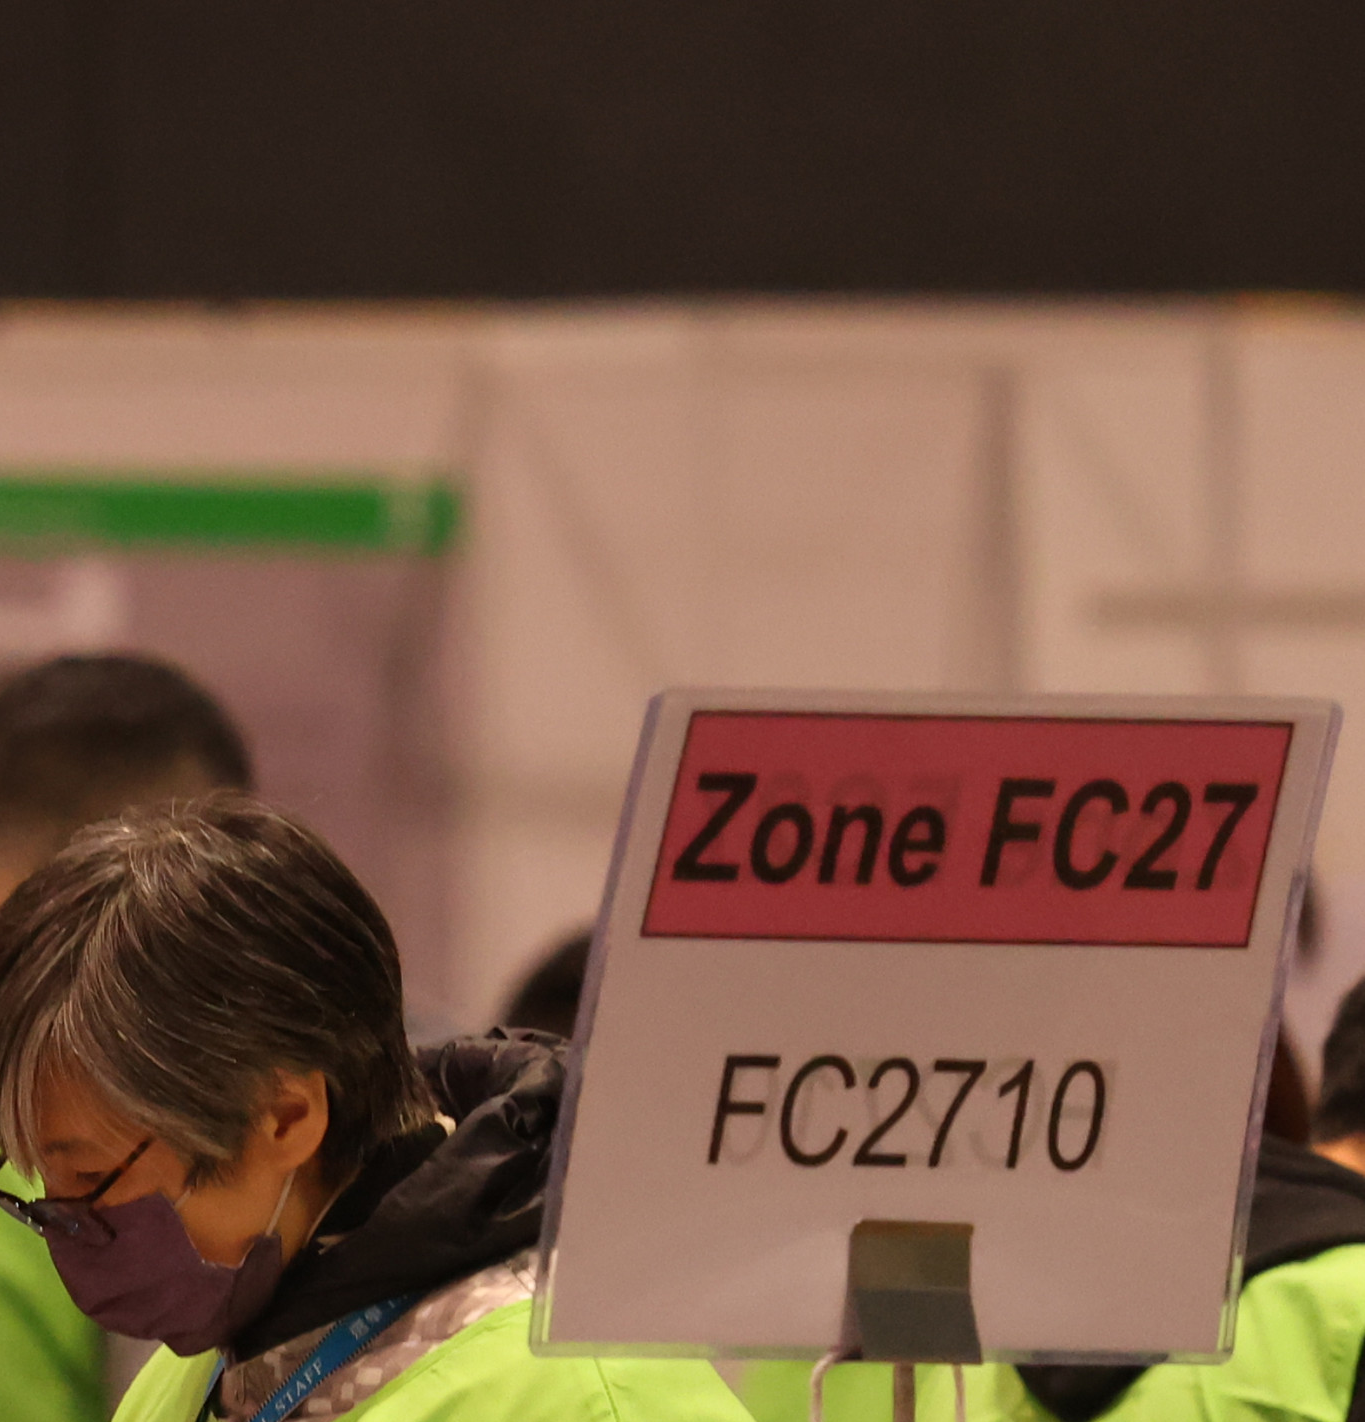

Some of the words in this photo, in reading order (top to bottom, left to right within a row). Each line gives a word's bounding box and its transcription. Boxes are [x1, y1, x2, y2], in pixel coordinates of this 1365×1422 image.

[670, 772, 948, 888] Zone
[980, 776, 1260, 892] FC27
[707, 1053, 1108, 1172] FC2710
[273, 1357, 324, 1415] STAFF
